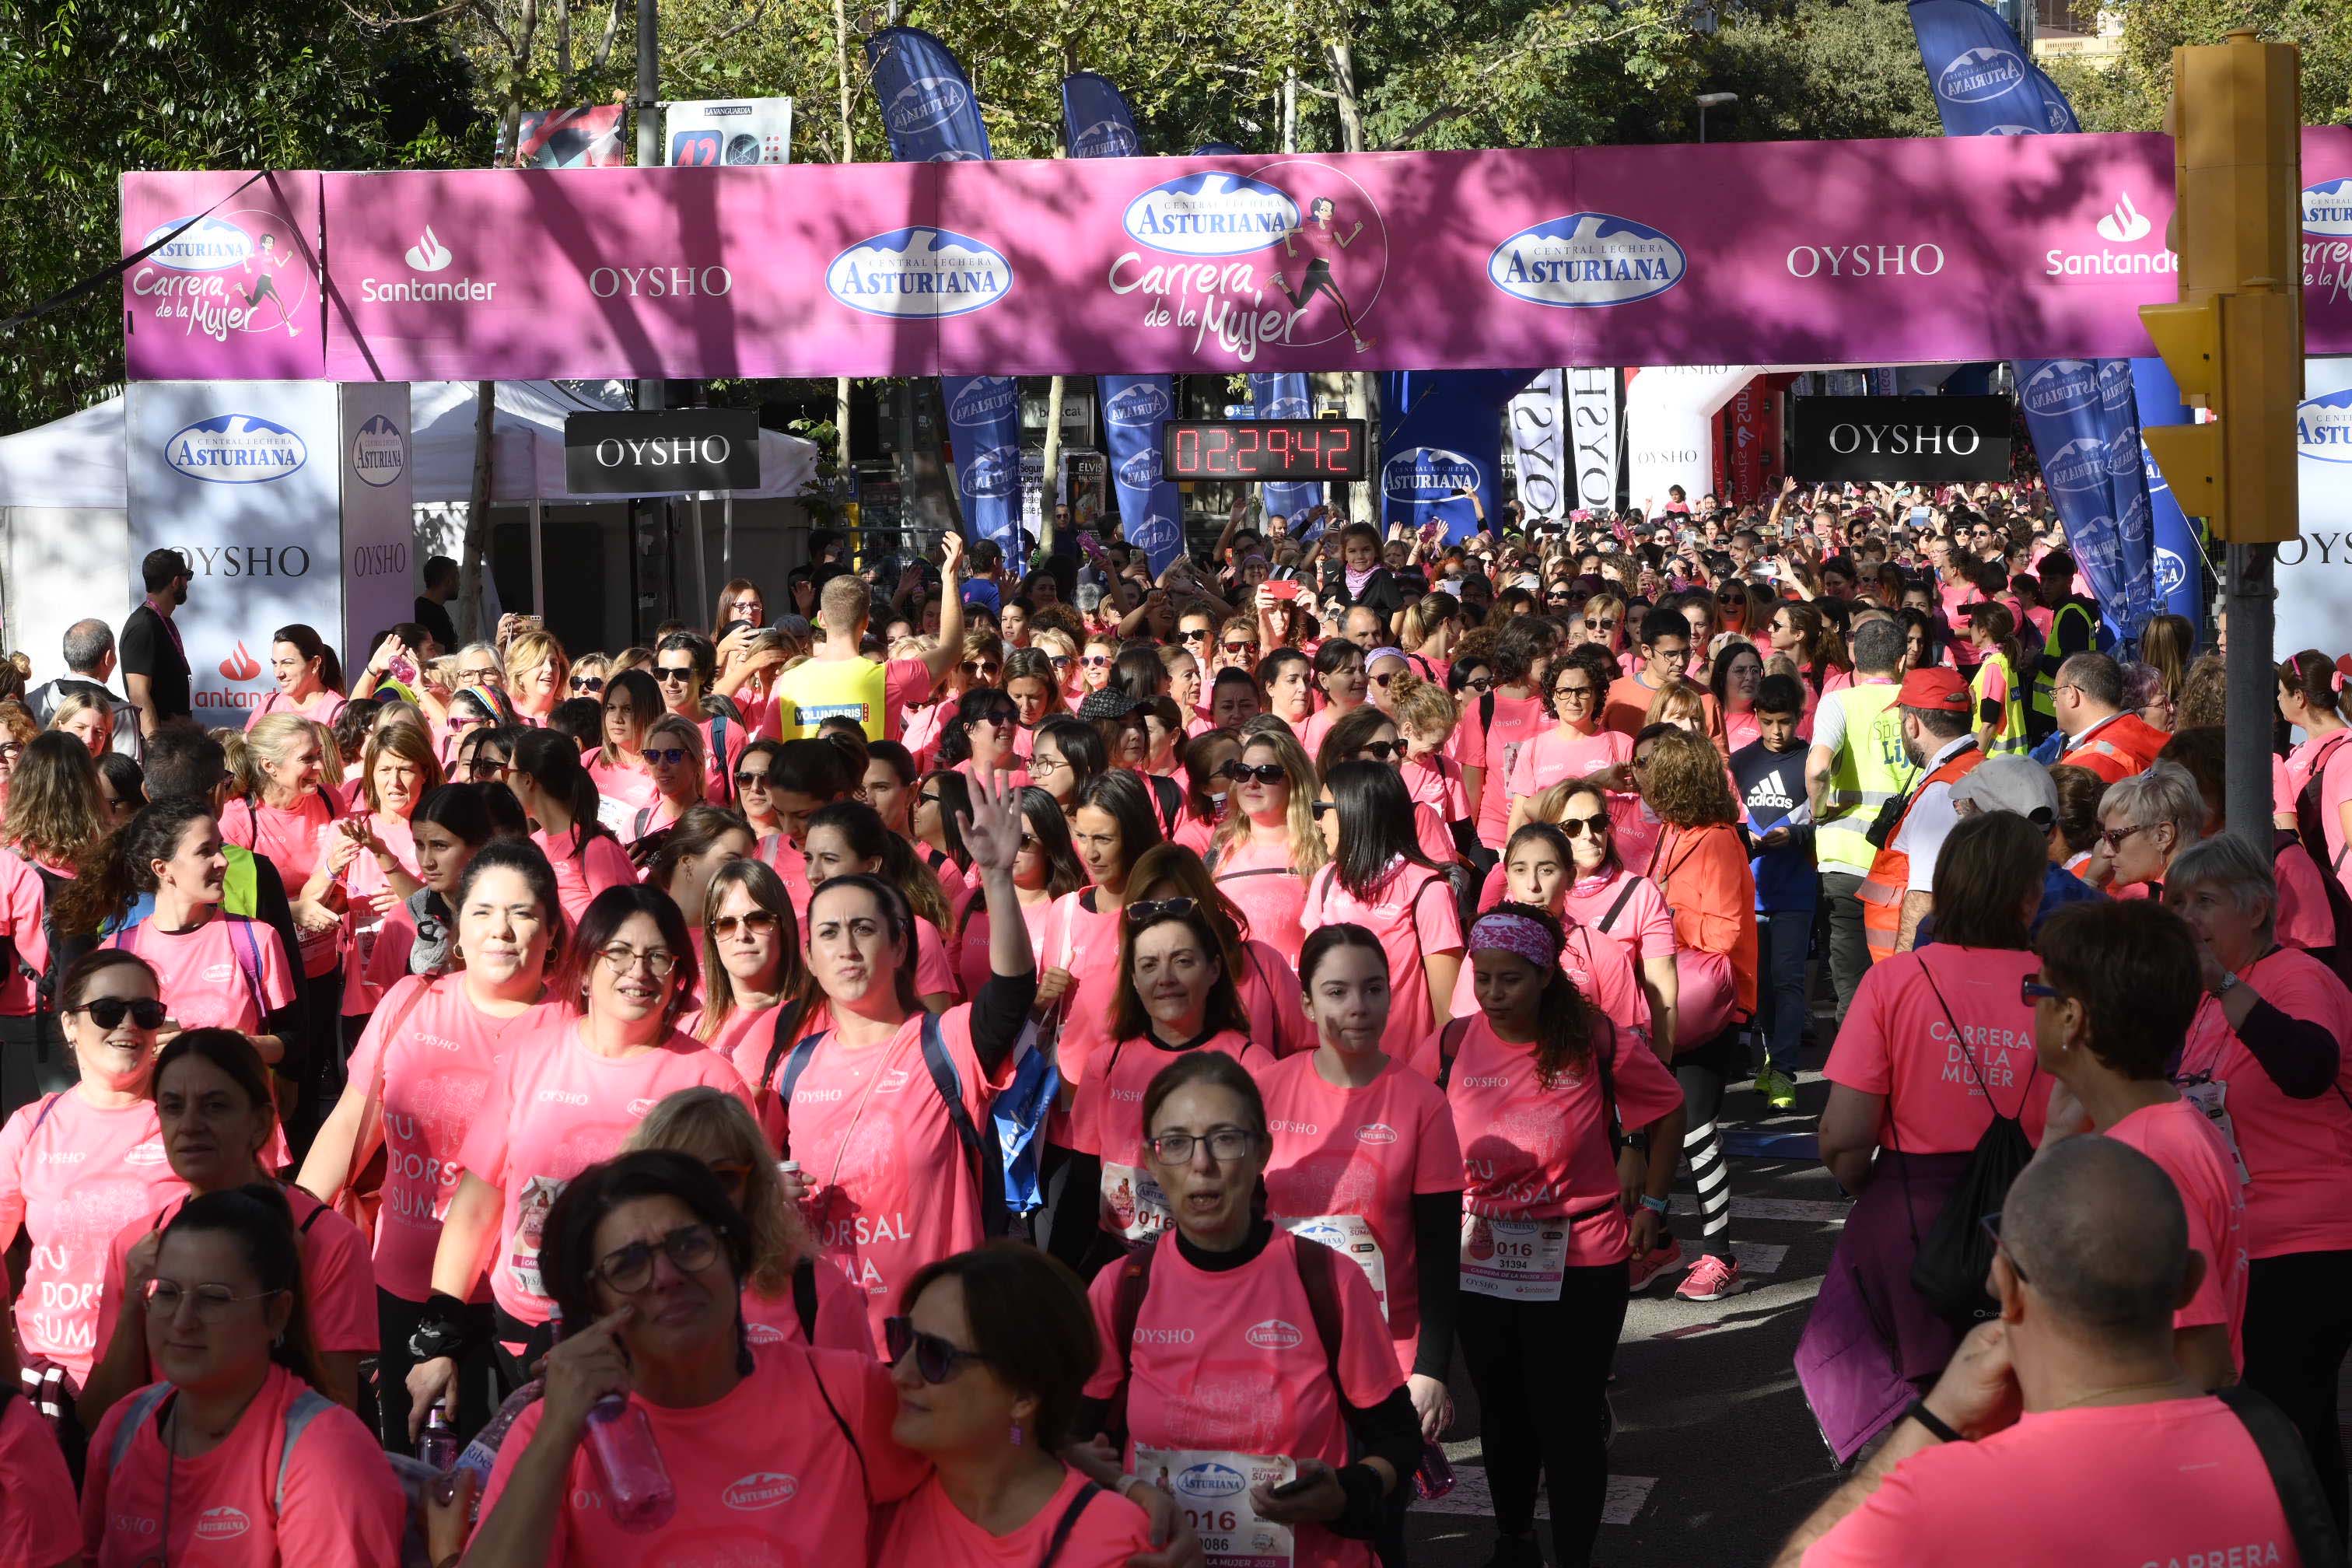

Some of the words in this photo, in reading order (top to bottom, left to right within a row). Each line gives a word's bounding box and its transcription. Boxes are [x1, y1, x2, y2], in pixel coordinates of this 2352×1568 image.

[1137, 203, 1286, 235] ASTURIANA
[152, 236, 243, 257] ASTURIANA
[1534, 245, 1595, 256] CENTRAL
[1601, 243, 1664, 254] LECHERA
[869, 258, 927, 268] CENTRAL
[933, 257, 992, 267] LECHERA
[1503, 249, 1671, 284] ASTURIANA
[1787, 243, 1944, 278] OYSHO
[2046, 248, 2178, 277] Santande
[133, 267, 224, 296] Carrera
[589, 266, 732, 297] OYSHO
[840, 261, 999, 295] ASTURIANA
[1108, 251, 1258, 296] Carrera
[2316, 268, 2333, 288] la
[361, 278, 497, 303] Santander
[156, 296, 173, 317] de
[176, 296, 188, 317] la
[187, 293, 260, 342] Mujer
[1143, 297, 1171, 328] de
[1176, 295, 1196, 328] la
[1192, 288, 1309, 362] Mujer
[2315, 414, 2352, 422] CENT
[1176, 429, 1350, 471] 02:29:42
[1829, 423, 1979, 455] OYSHO
[177, 439, 298, 467] ASTURIANA
[356, 441, 401, 469] ASTURIANA
[597, 434, 731, 467] OYSHO
[1638, 450, 1697, 464] OYSHO
[1078, 462, 1102, 473] ELVIS
[1386, 469, 1473, 491] ASTURIANA
[355, 542, 405, 578] OYSHO
[2275, 537, 2352, 567] OYS
[796, 706, 860, 721] VOLUNTARIS
[1747, 793, 1794, 809] adidas
[415, 1031, 460, 1052] OYSHO
[1930, 1021, 2032, 1050] CARRERA
[1947, 1045, 1976, 1065] DE
[1984, 1048, 2011, 1068] LA
[1463, 1075, 1509, 1089] OYSHO
[1941, 1063, 2014, 1087] MUJER
[796, 1089, 842, 1103] OYSHO
[1270, 1118, 1318, 1136] OYSHO
[1357, 1129, 1395, 1143] ASTURIANA
[391, 1149, 457, 1188] DORS
[1496, 1241, 1532, 1257] 016
[1499, 1258, 1528, 1269] 31394
[870, 1286, 888, 1296] 2023
[1465, 1277, 1499, 1290] OYSHO
[33, 1311, 98, 1348] SUM
[1133, 1327, 1195, 1345] OYSHO
[1251, 1331, 1298, 1344] ASTURIANA
[1181, 1475, 1241, 1489] ASTURIANA
[1251, 1472, 1283, 1482] SUMA
[728, 1481, 796, 1504] ASTURIANA
[198, 1519, 245, 1532] ASTURIANA
[1220, 1559, 1251, 1568] MUJER
